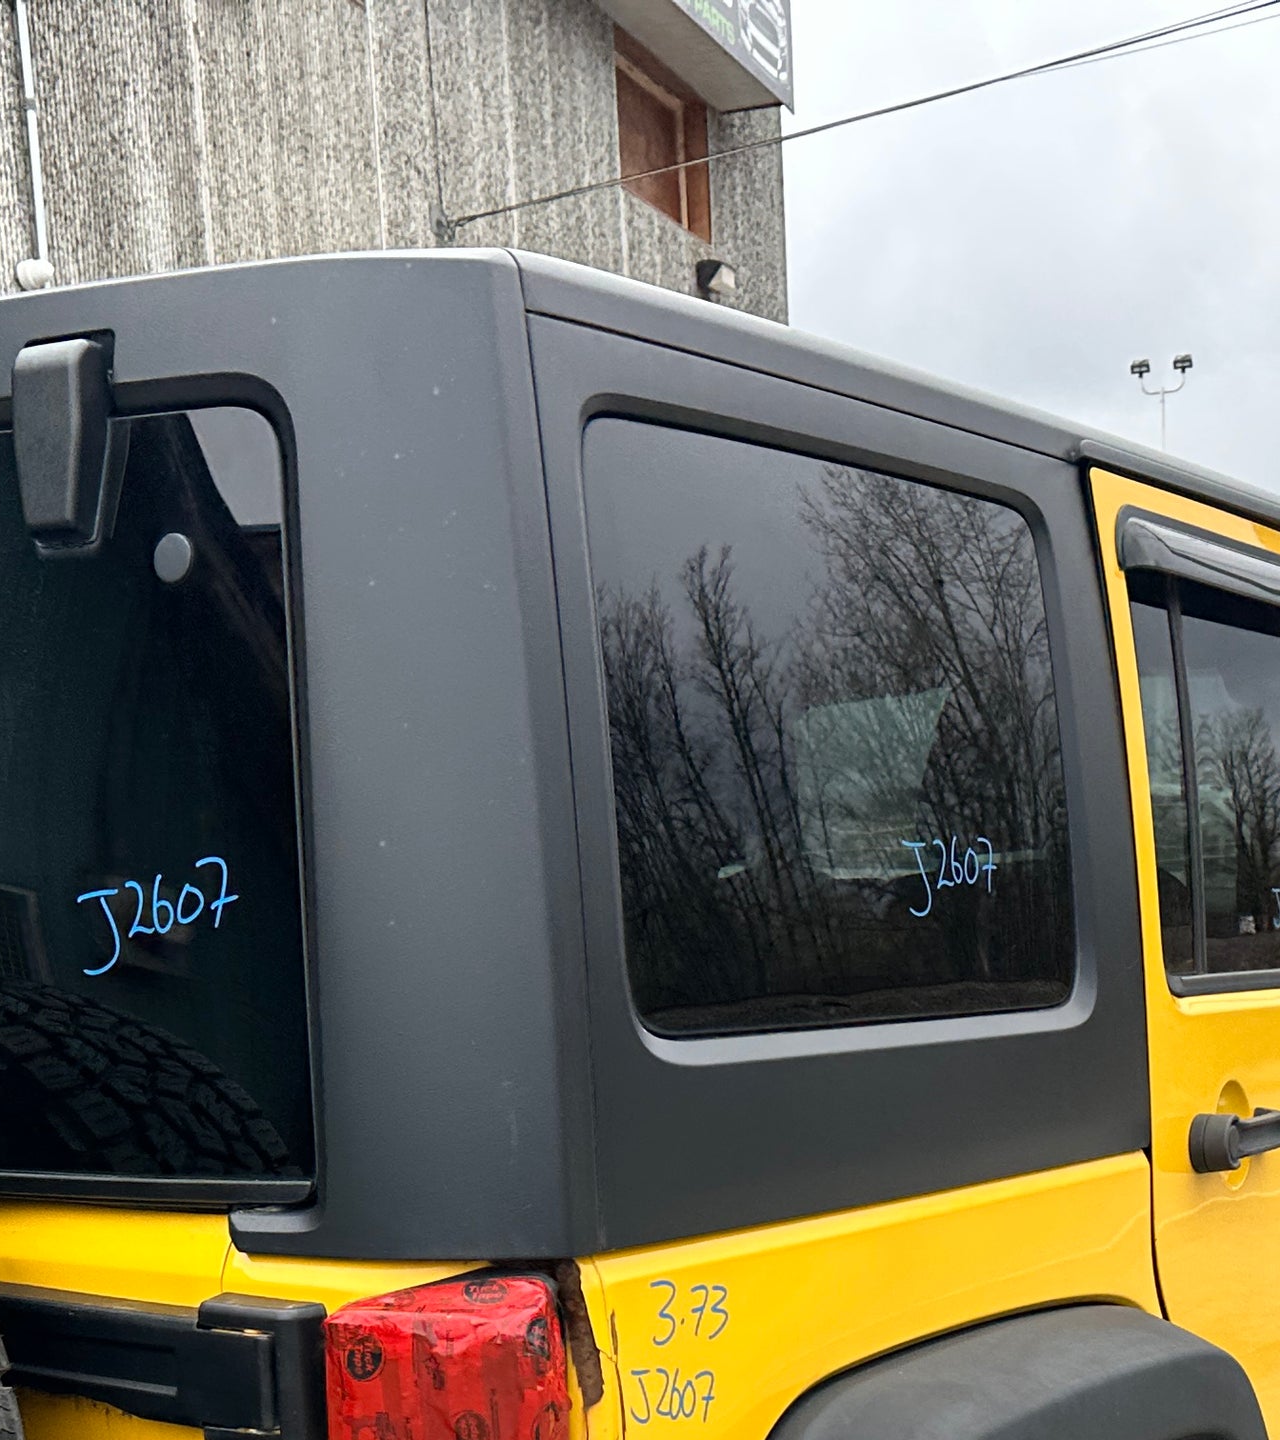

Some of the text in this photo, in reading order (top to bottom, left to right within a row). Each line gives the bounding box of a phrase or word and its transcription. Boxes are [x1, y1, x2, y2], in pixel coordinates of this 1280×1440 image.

[901, 836, 998, 917] J2607
[77, 856, 239, 976] J2607
[649, 1279, 729, 1346] 3.73
[352, 1344, 364, 1376] Tape
[363, 1340, 375, 1372] Tuck
[630, 1367, 716, 1425] J2607
